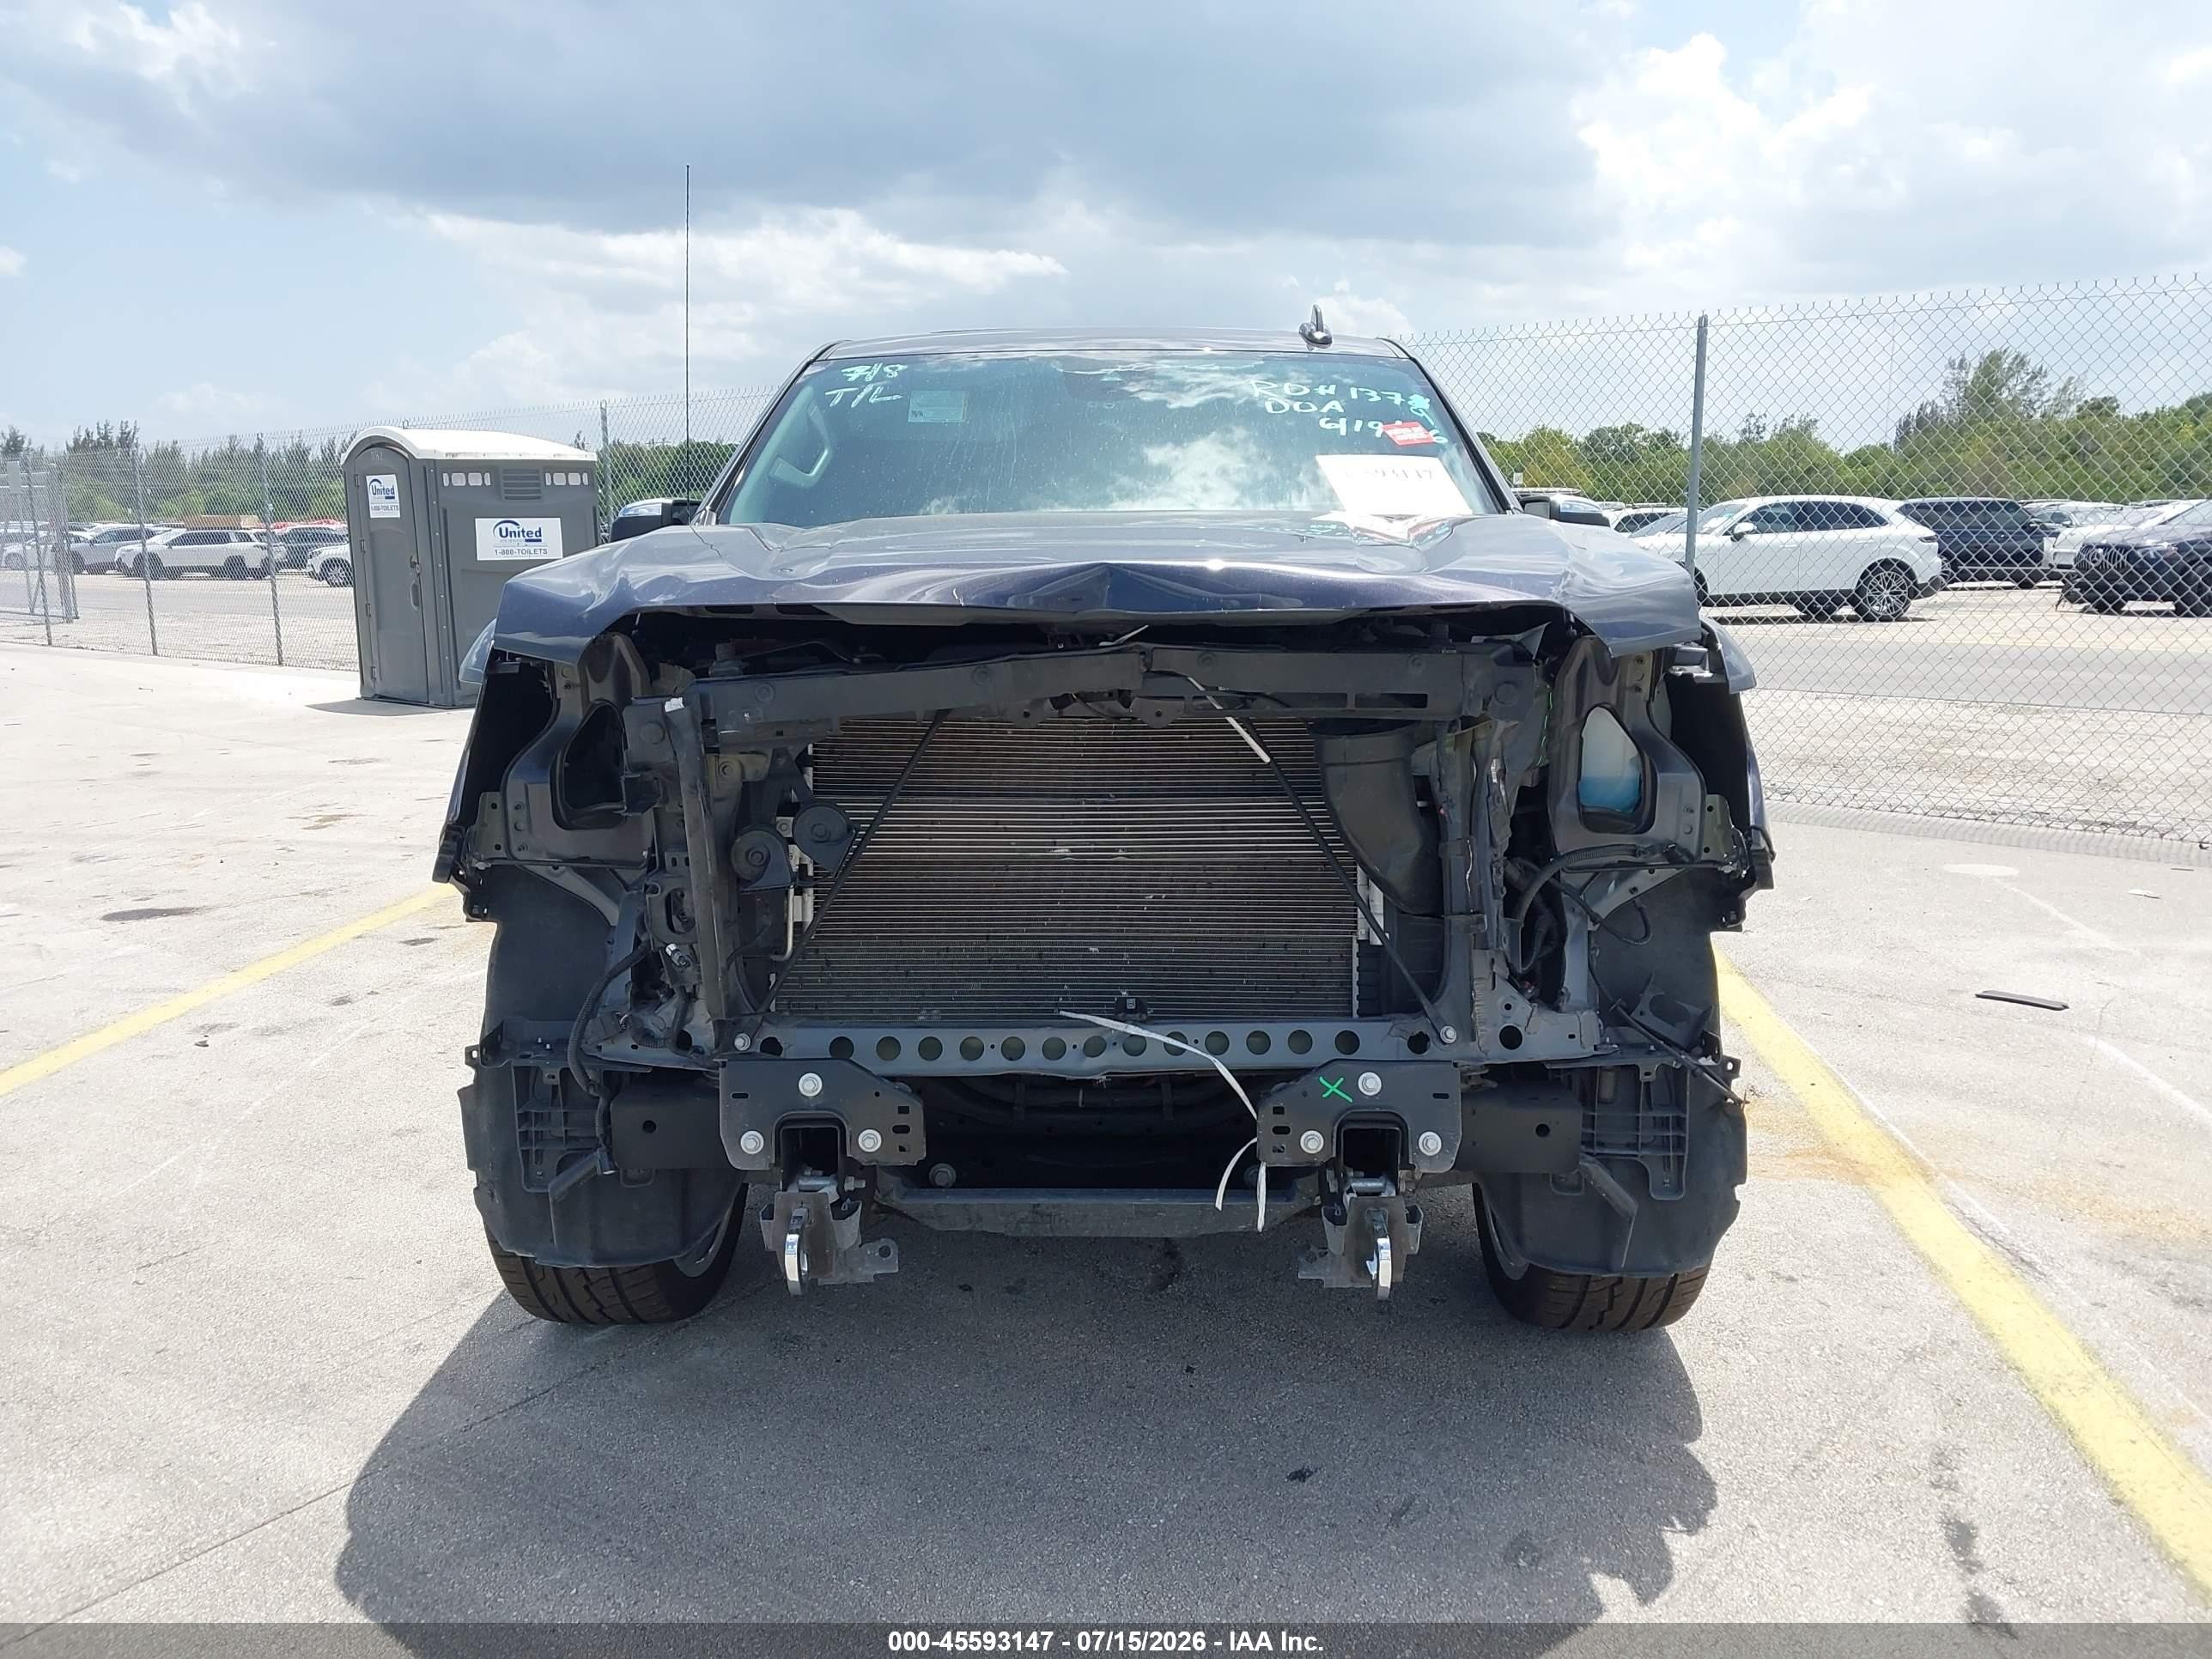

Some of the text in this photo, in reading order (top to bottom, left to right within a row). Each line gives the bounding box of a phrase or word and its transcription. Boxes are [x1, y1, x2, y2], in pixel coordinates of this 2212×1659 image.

[371, 484, 395, 495] United
[499, 526, 543, 538] United
[495, 548, 549, 556] 1-800-TOILETS
